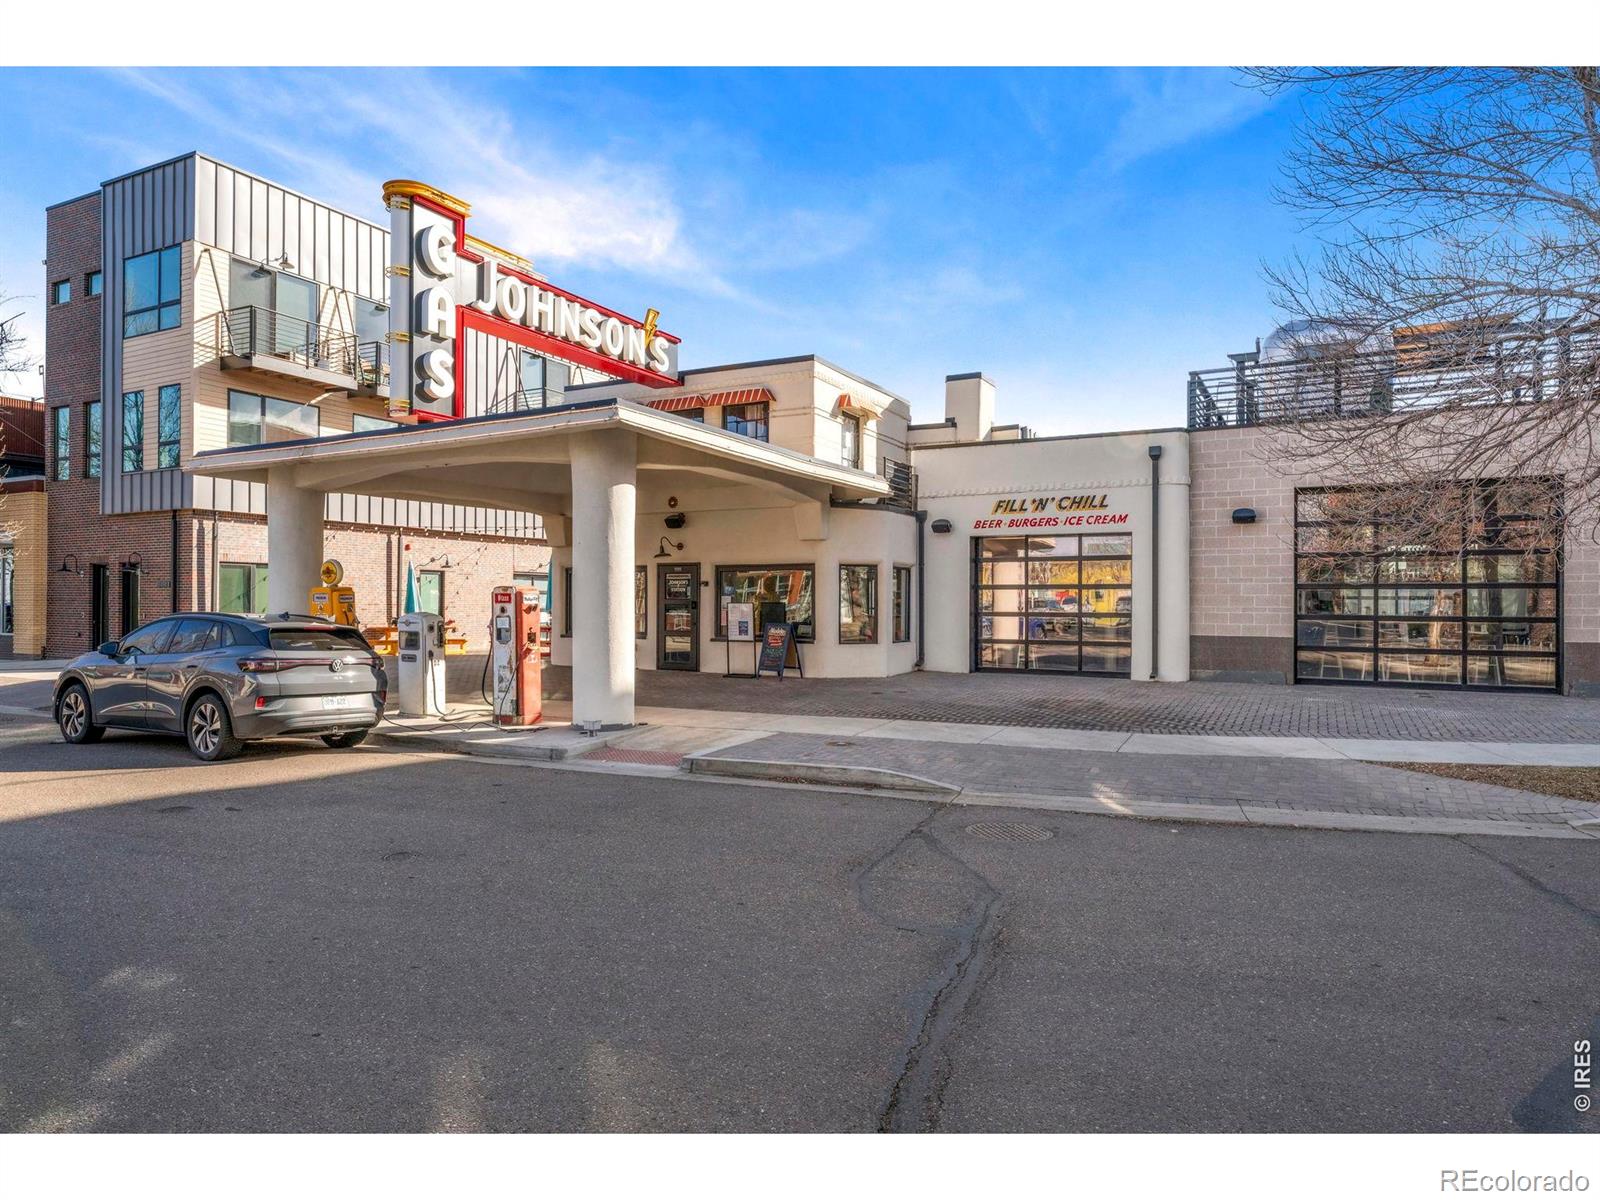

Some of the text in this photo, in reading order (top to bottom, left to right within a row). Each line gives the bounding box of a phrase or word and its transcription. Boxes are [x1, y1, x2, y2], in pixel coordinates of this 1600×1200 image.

[415, 223, 456, 403] GAS
[471, 257, 670, 373] JOHNSON'S
[973, 513, 1129, 529] BEER BURGERS ICE CREAM
[992, 499, 1028, 515] FILL
[1056, 494, 1109, 512] CHILL
